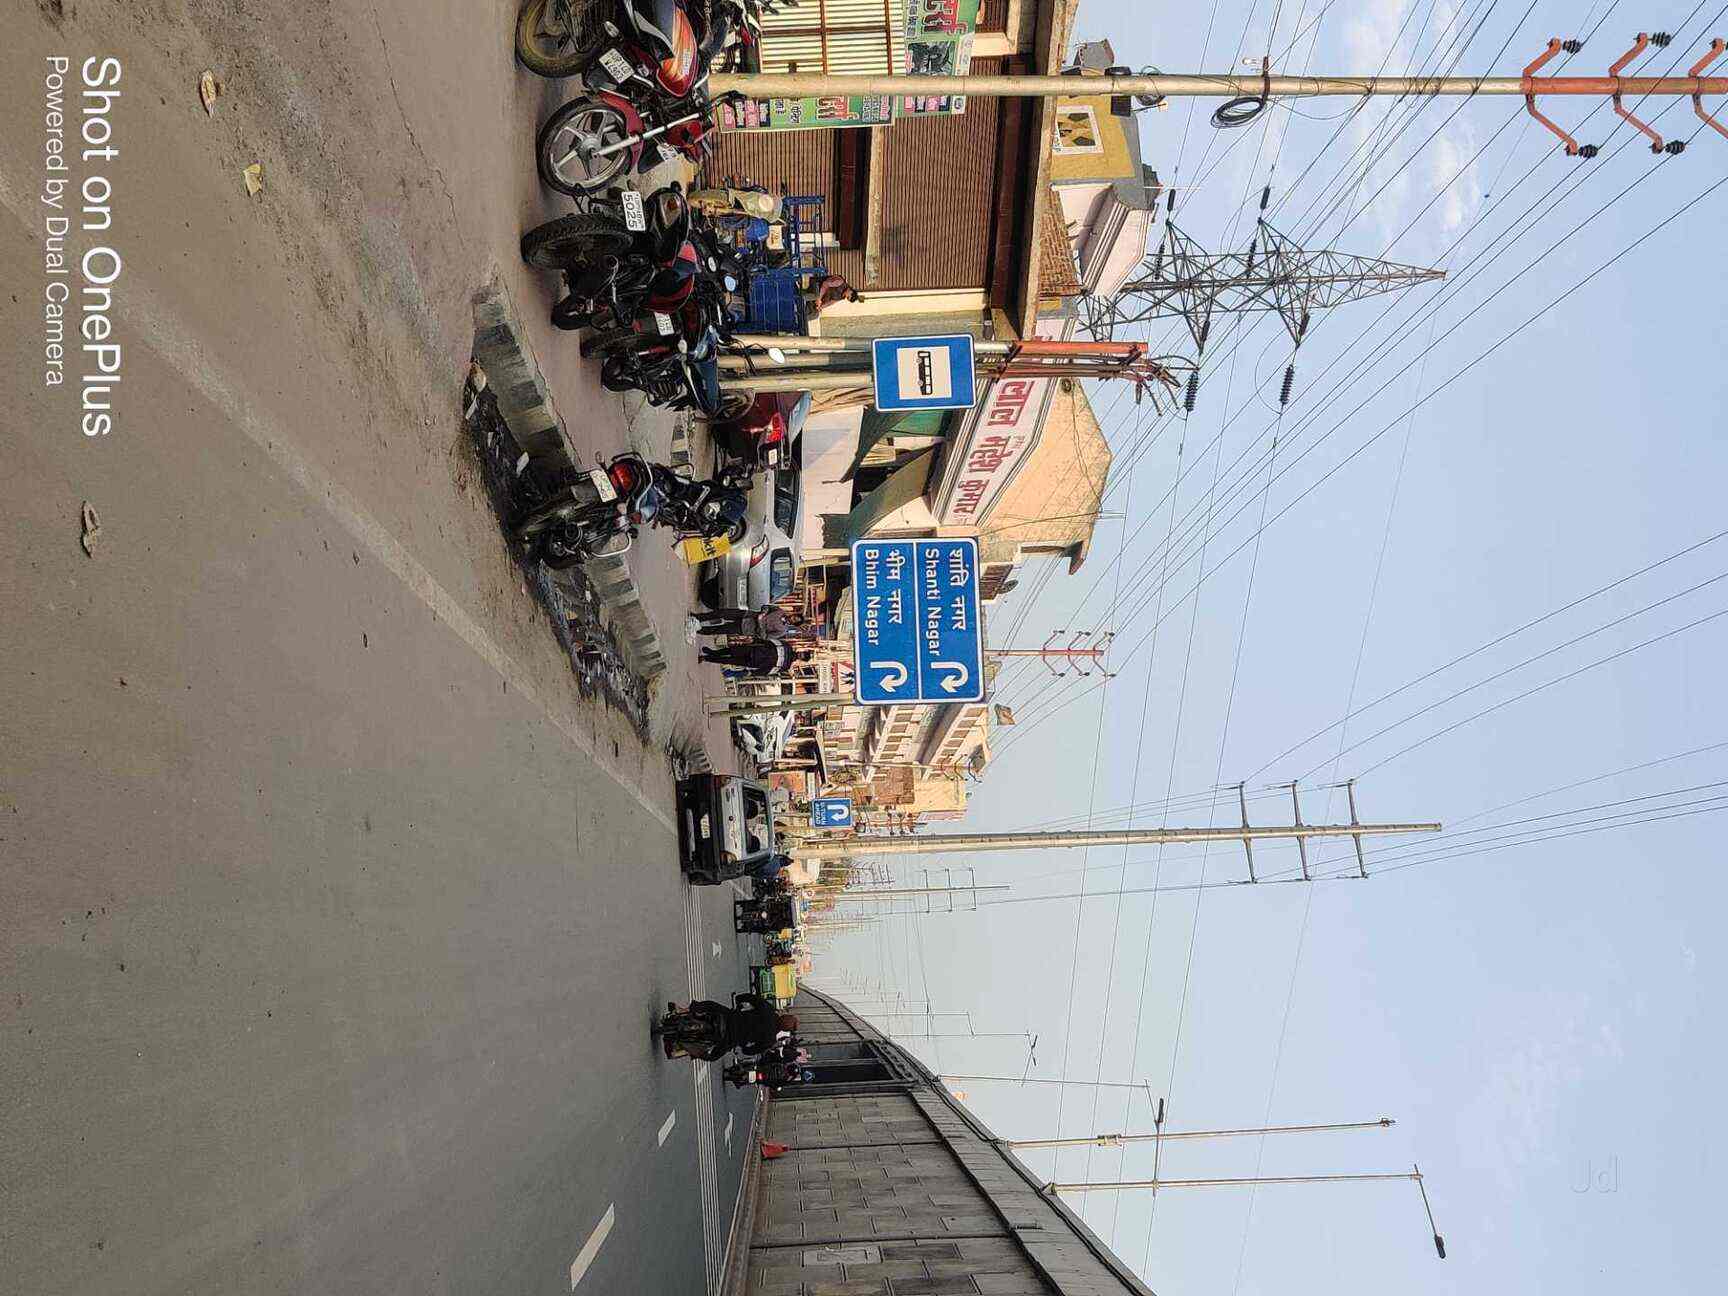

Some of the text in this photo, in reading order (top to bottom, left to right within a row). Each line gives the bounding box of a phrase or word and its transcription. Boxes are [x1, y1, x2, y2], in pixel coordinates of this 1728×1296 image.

[624, 194, 637, 228] 5025
[953, 380, 1034, 515] लाल महेश कुमार
[864, 549, 880, 646] Bhim Nagar
[886, 549, 906, 624] भीम नगर
[925, 548, 942, 656] Shanti Nagar
[949, 548, 969, 631] शांति नगर
